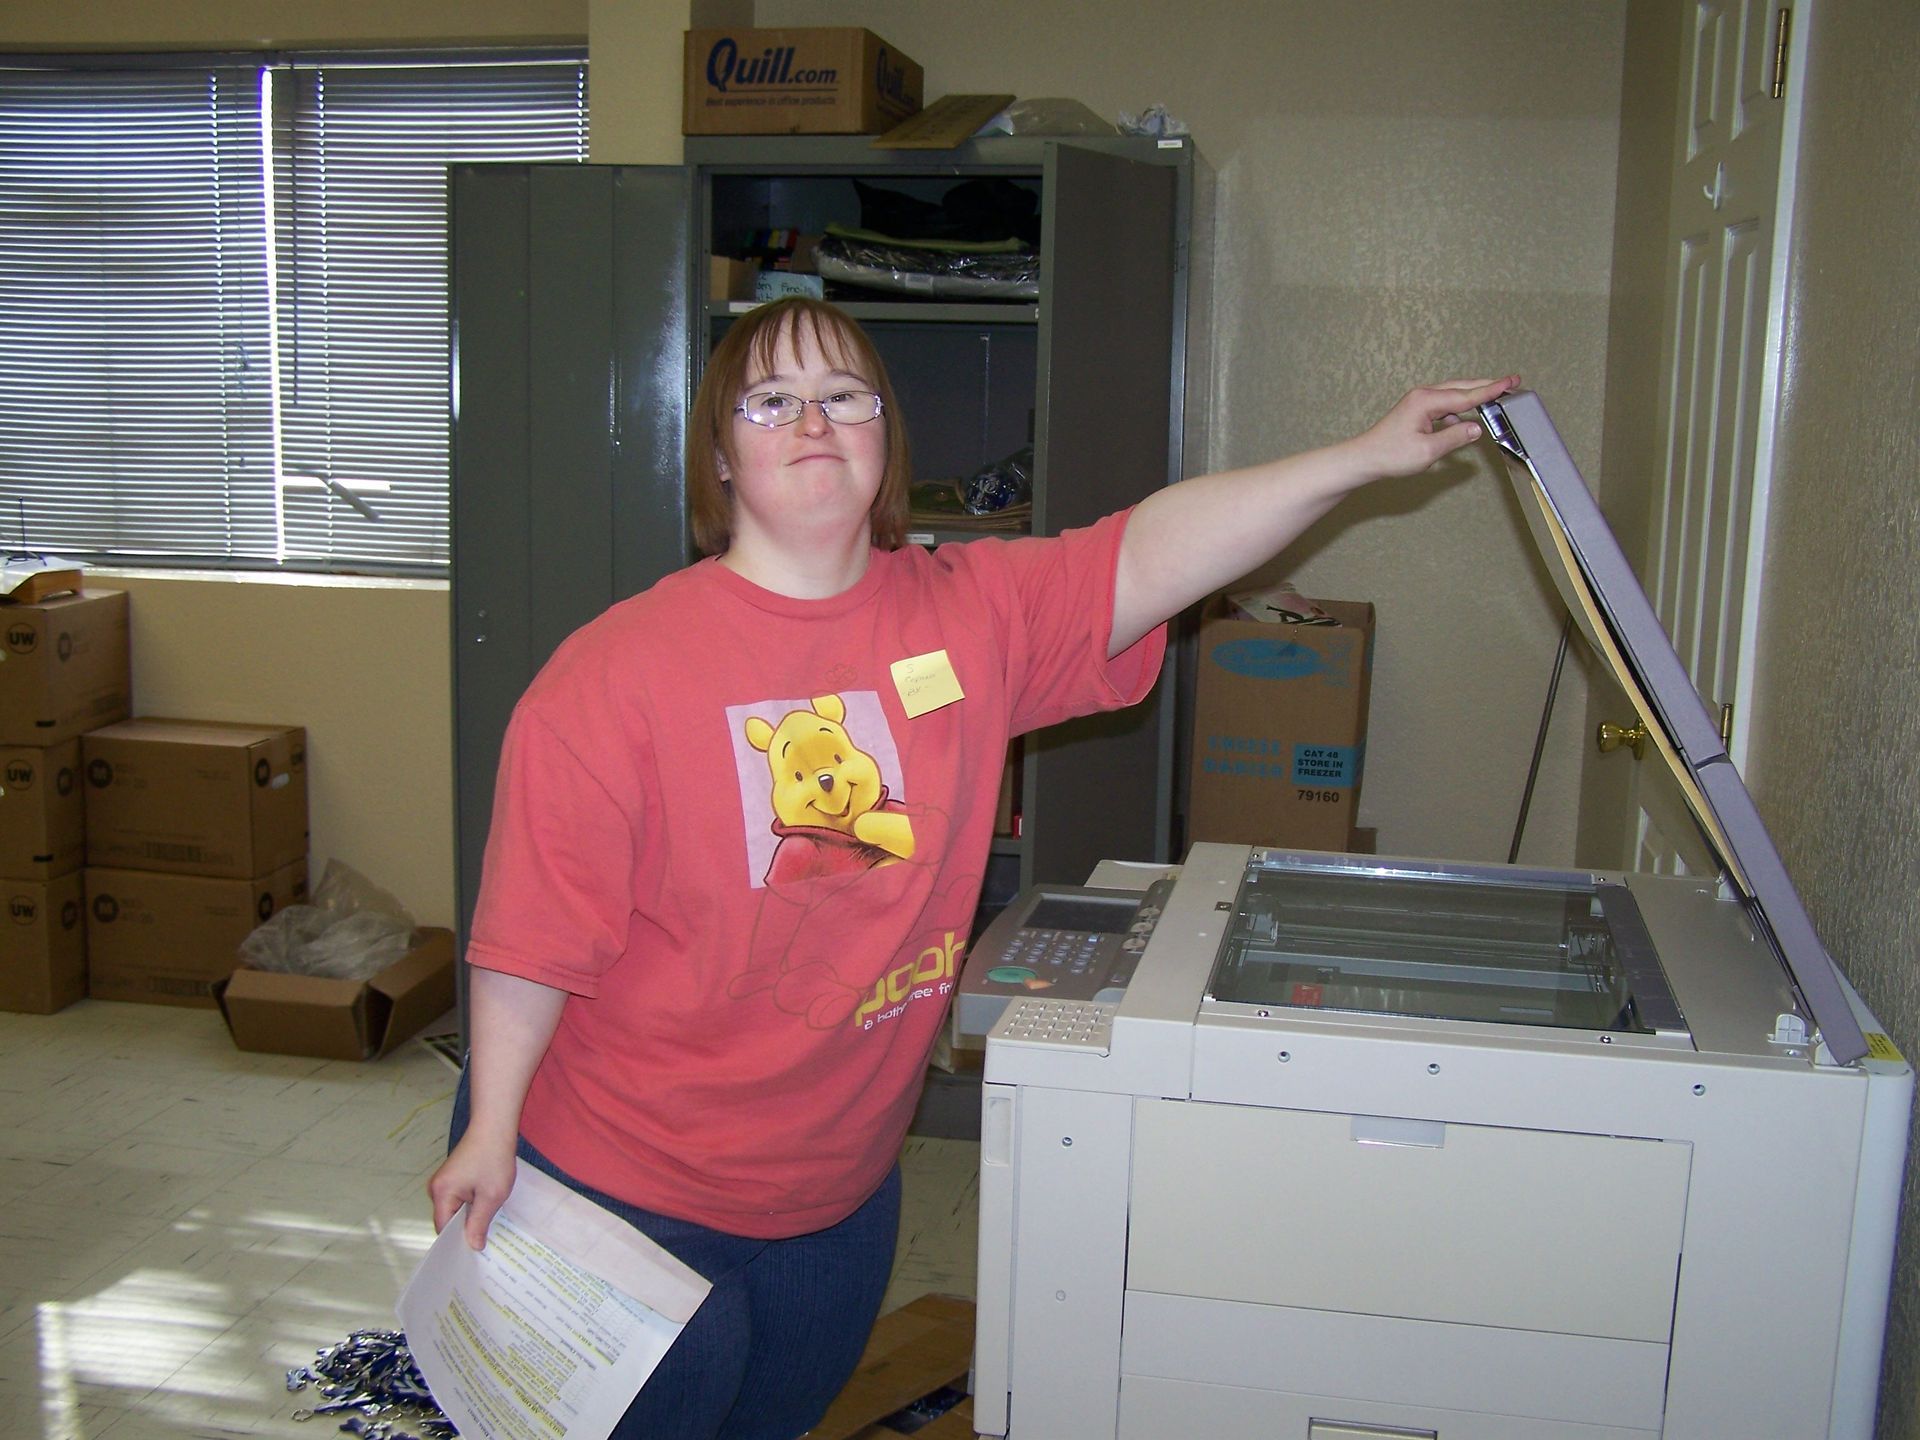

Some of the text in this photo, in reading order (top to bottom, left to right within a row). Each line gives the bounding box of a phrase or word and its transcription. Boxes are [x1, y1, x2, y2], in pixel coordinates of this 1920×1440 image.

[706, 37, 837, 93] Quill.com
[9, 631, 35, 646] UW
[1304, 749, 1324, 758] CAT
[1297, 758, 1344, 769] STORE IN
[7, 767, 33, 784] UW
[1297, 768, 1342, 778] FREEZER
[1296, 789, 1340, 803] 79160
[11, 903, 35, 918] UW
[864, 1019, 873, 1030] a
